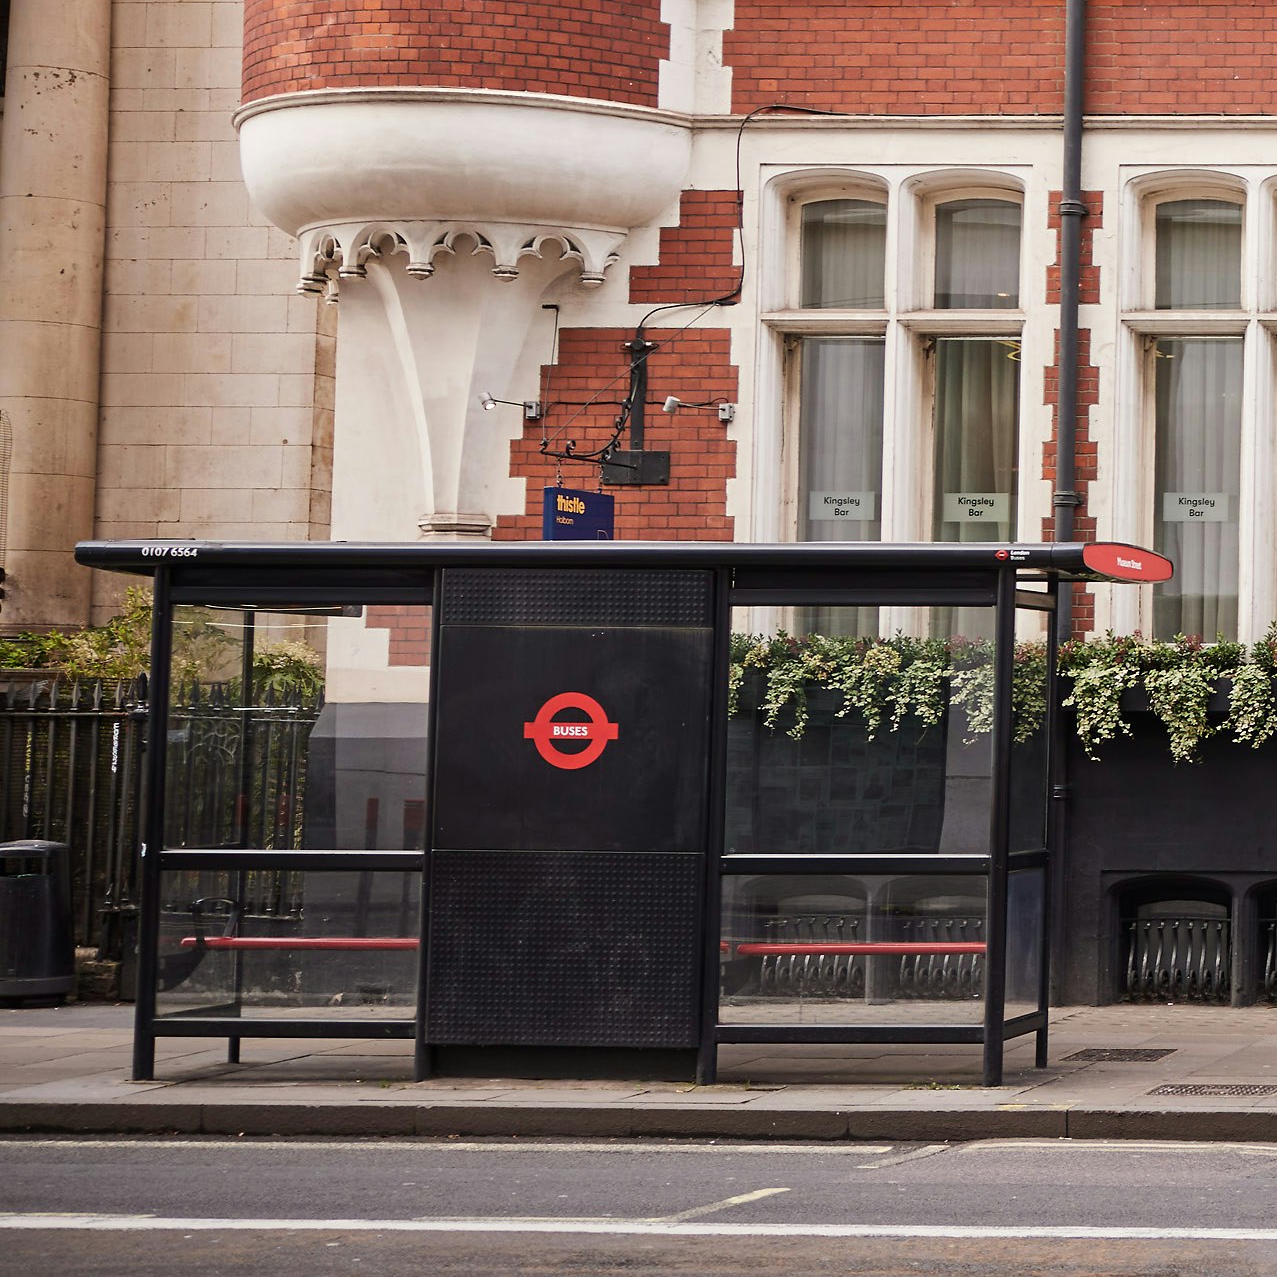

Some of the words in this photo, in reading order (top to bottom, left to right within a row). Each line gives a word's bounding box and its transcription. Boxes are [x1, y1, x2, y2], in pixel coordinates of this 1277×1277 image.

[556, 494, 586, 514] thistle
[823, 496, 860, 506] Kingsley
[957, 497, 995, 507] Kingsley
[1178, 497, 1215, 508] Kingsley
[834, 508, 850, 516] Bar
[968, 509, 983, 517] Bar
[1189, 509, 1204, 517] Bar
[141, 547, 170, 556] 0107
[170, 547, 198, 557] 6564
[553, 726, 588, 736] BUSES
